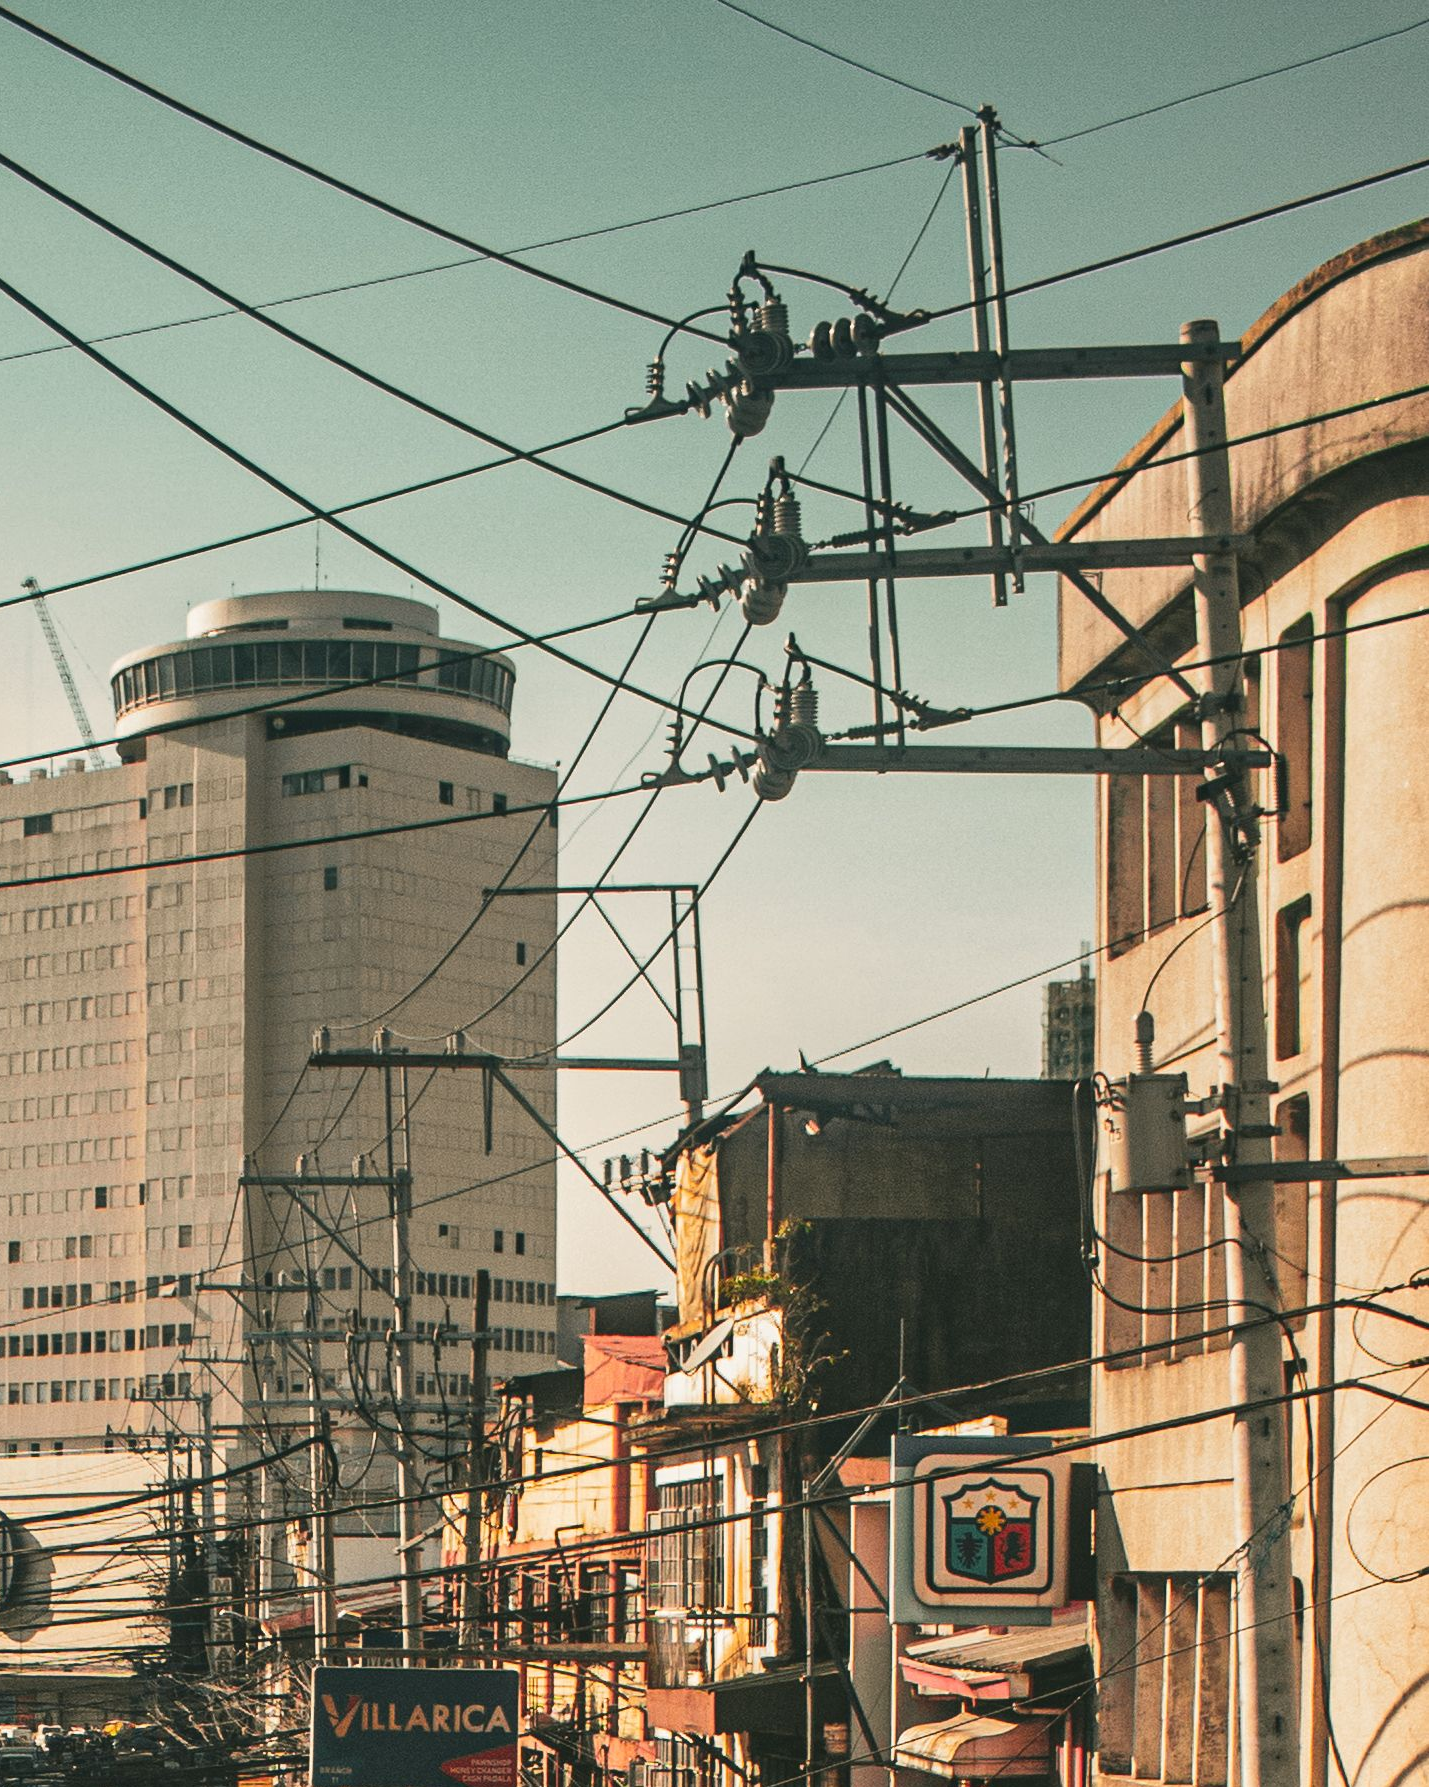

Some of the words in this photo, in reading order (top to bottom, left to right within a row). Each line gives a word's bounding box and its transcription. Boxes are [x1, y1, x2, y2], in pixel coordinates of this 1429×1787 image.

[321, 1693, 512, 1738] VILLARICA
[319, 1766, 353, 1775] BRANCH
[483, 1775, 513, 1783] PADALA
